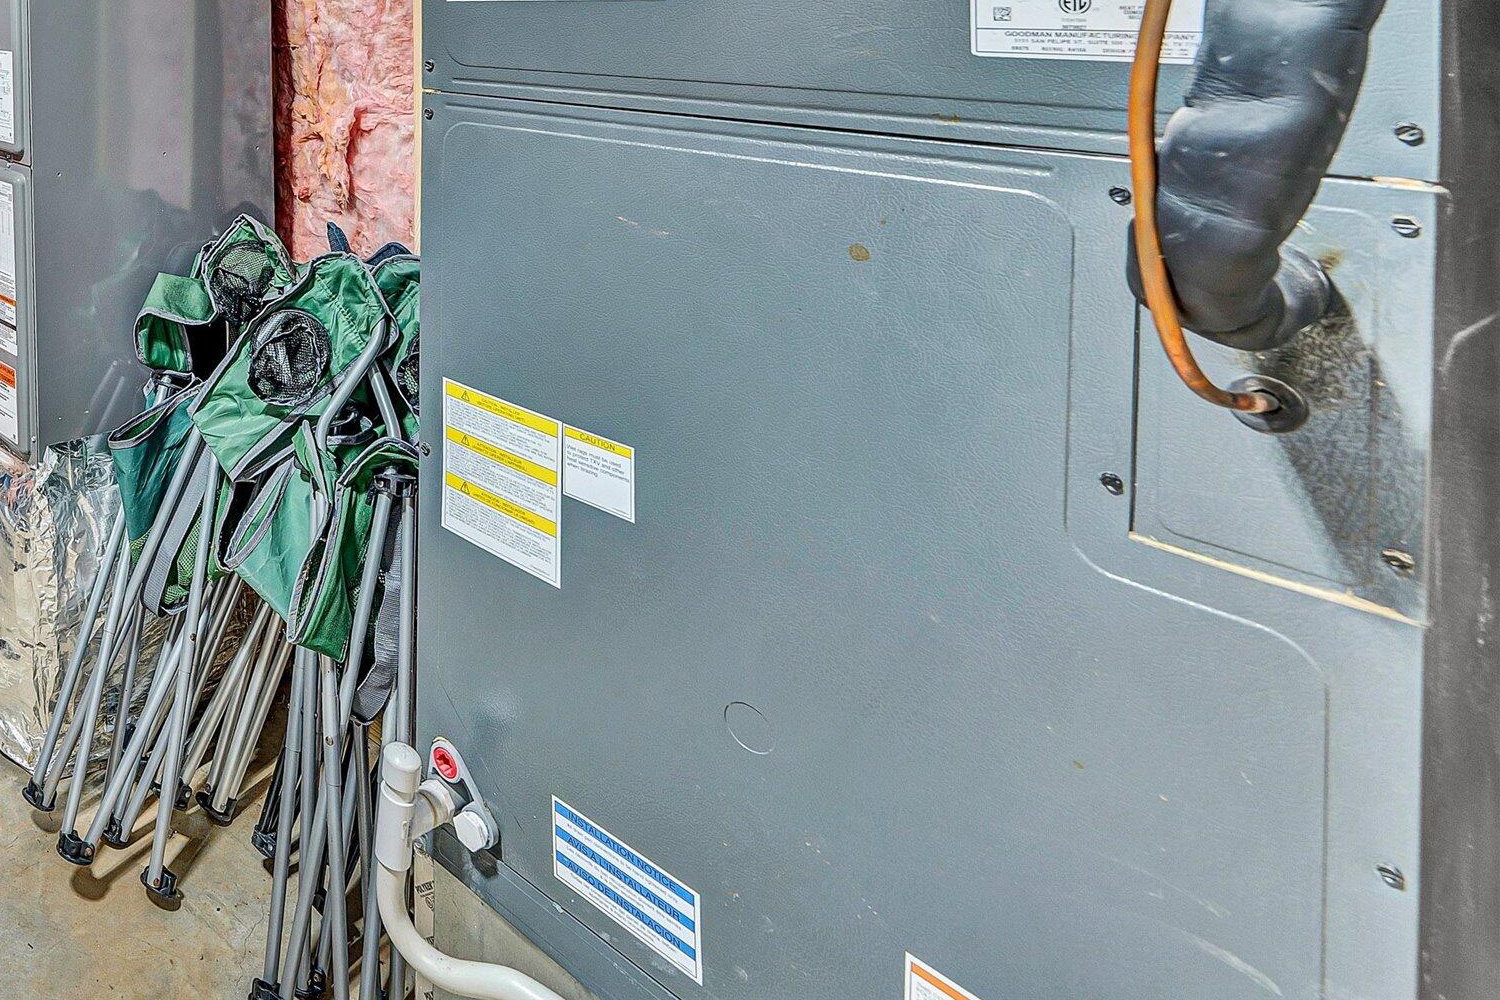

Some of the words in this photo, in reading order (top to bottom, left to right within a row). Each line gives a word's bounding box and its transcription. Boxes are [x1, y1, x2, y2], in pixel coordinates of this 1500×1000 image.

[1004, 30, 1053, 39] GOODMAN
[579, 432, 615, 451] CAUTION
[567, 834, 588, 856] AVIS
[567, 810, 634, 864] INSTALLATION
[636, 856, 676, 893] NOTICE
[567, 859, 595, 887] AVISO
[597, 881, 611, 899] DE
